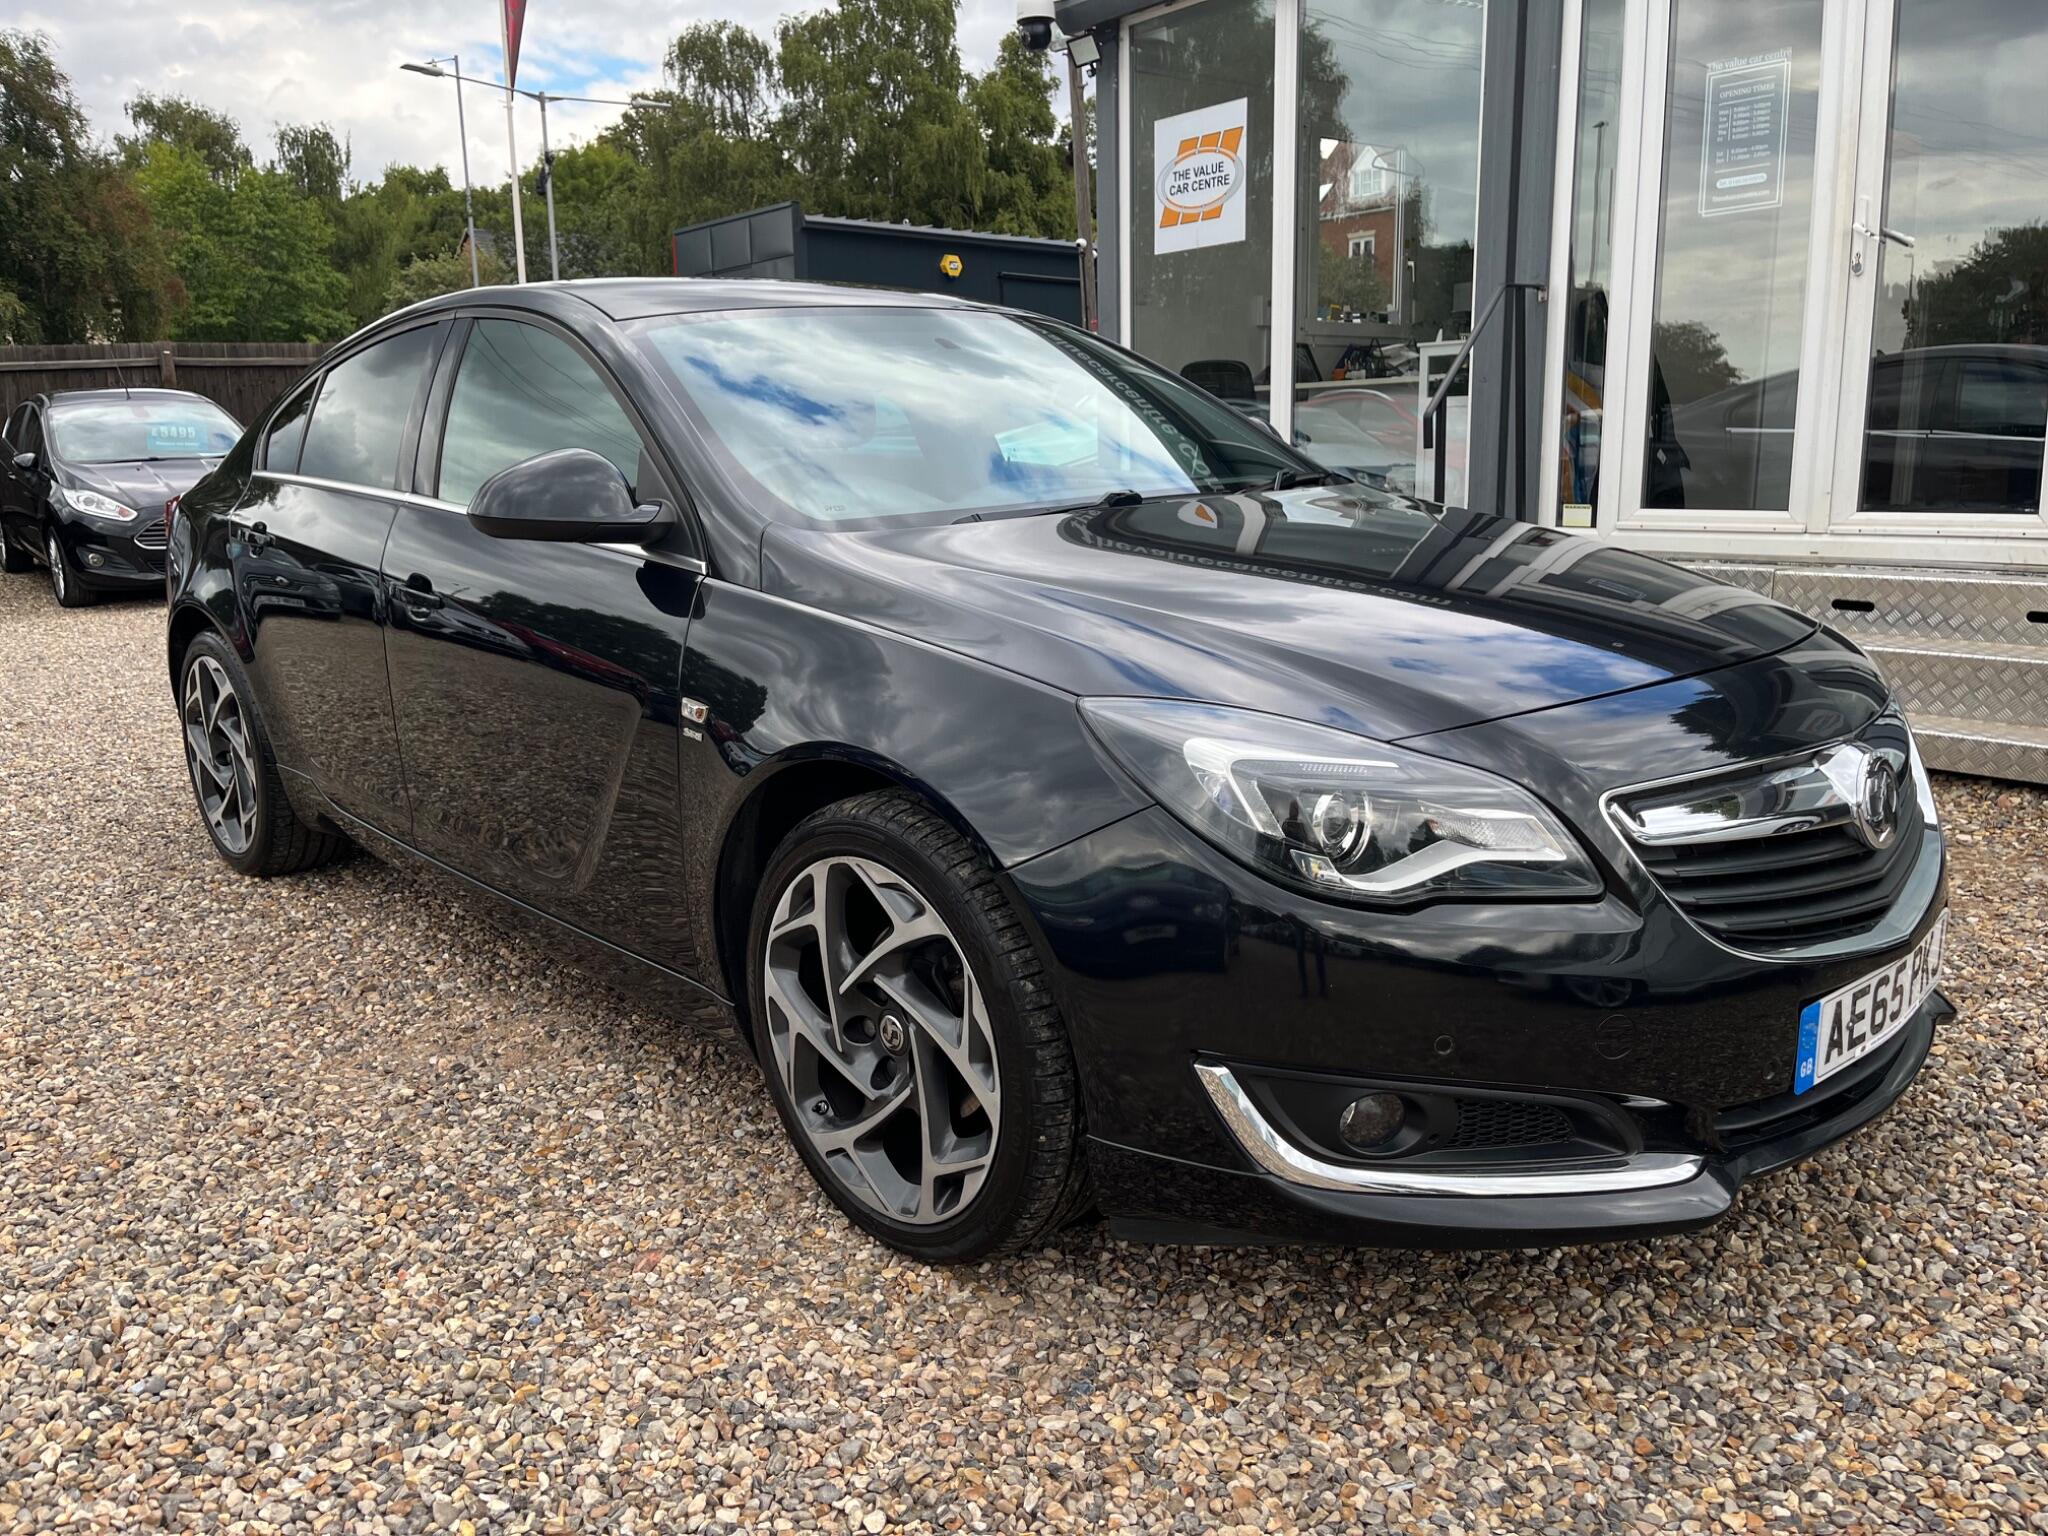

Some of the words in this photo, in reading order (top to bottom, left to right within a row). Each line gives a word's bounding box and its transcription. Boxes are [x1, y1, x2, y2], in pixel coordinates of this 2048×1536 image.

[1724, 56, 1748, 70] value
[1749, 55, 1764, 64] car
[1720, 86, 1752, 98] OPENING
[1173, 168, 1191, 182] THE
[1193, 161, 1224, 178] VALUE
[1169, 182, 1189, 196] CAR
[1192, 174, 1230, 192] CENTRE
[1824, 959, 1908, 1066] AE65
[1908, 919, 1945, 1007] PKJ
[1800, 1058, 1813, 1078] GB
